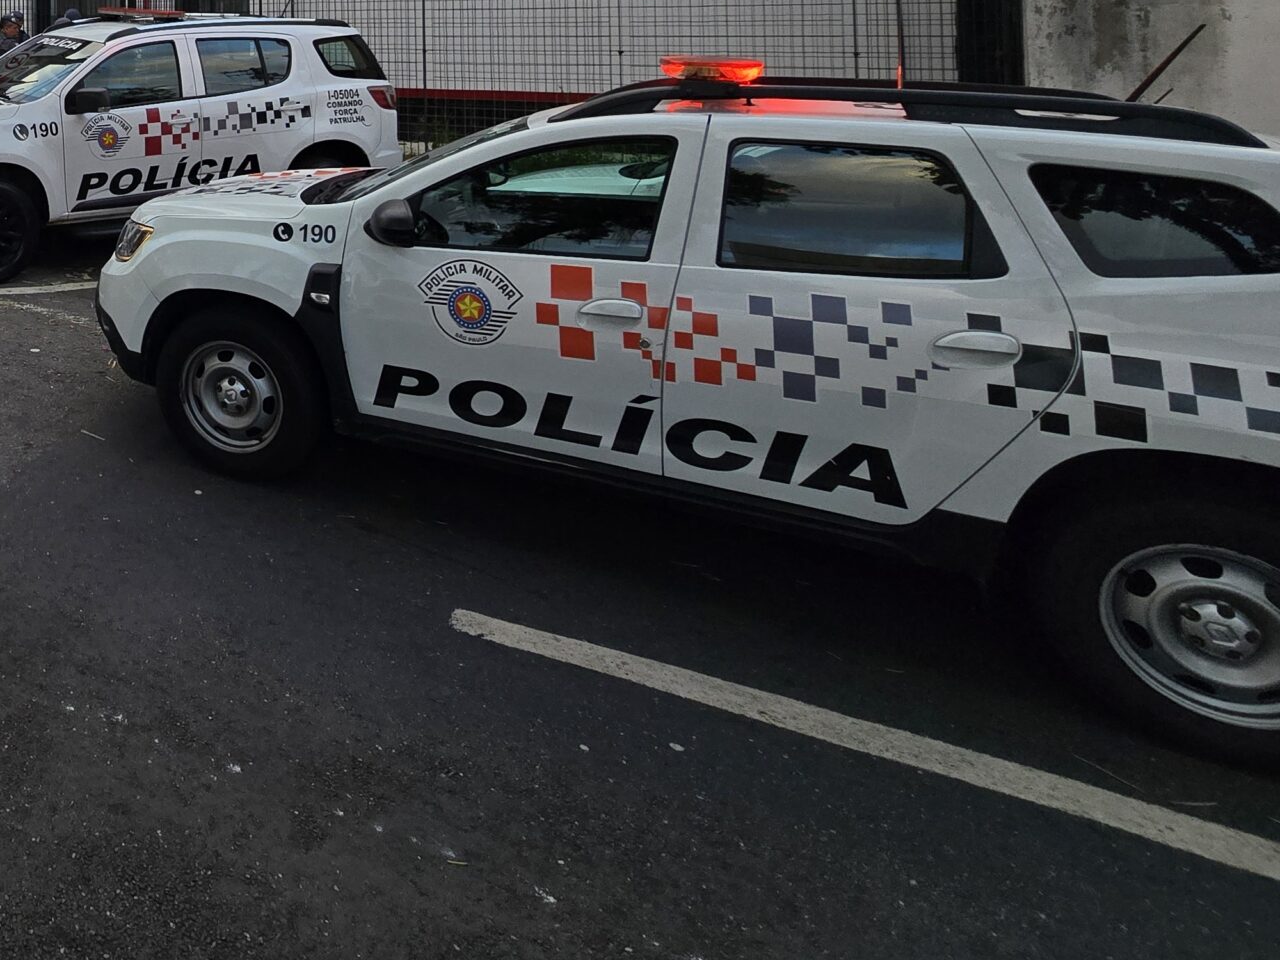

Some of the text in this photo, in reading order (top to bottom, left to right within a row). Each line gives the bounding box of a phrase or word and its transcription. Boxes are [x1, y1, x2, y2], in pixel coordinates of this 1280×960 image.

[326, 99, 363, 108] COMANDO
[333, 108, 359, 116] FORÇA
[30, 121, 59, 139] 190
[84, 115, 130, 135] POLÍCIA MILITAR
[329, 115, 365, 125] PATRULHA
[76, 153, 261, 201] POLÍCIA
[299, 223, 336, 244] 190
[424, 263, 516, 300] POLÍCIA MILITAR
[372, 364, 909, 509] POLÍCIA
